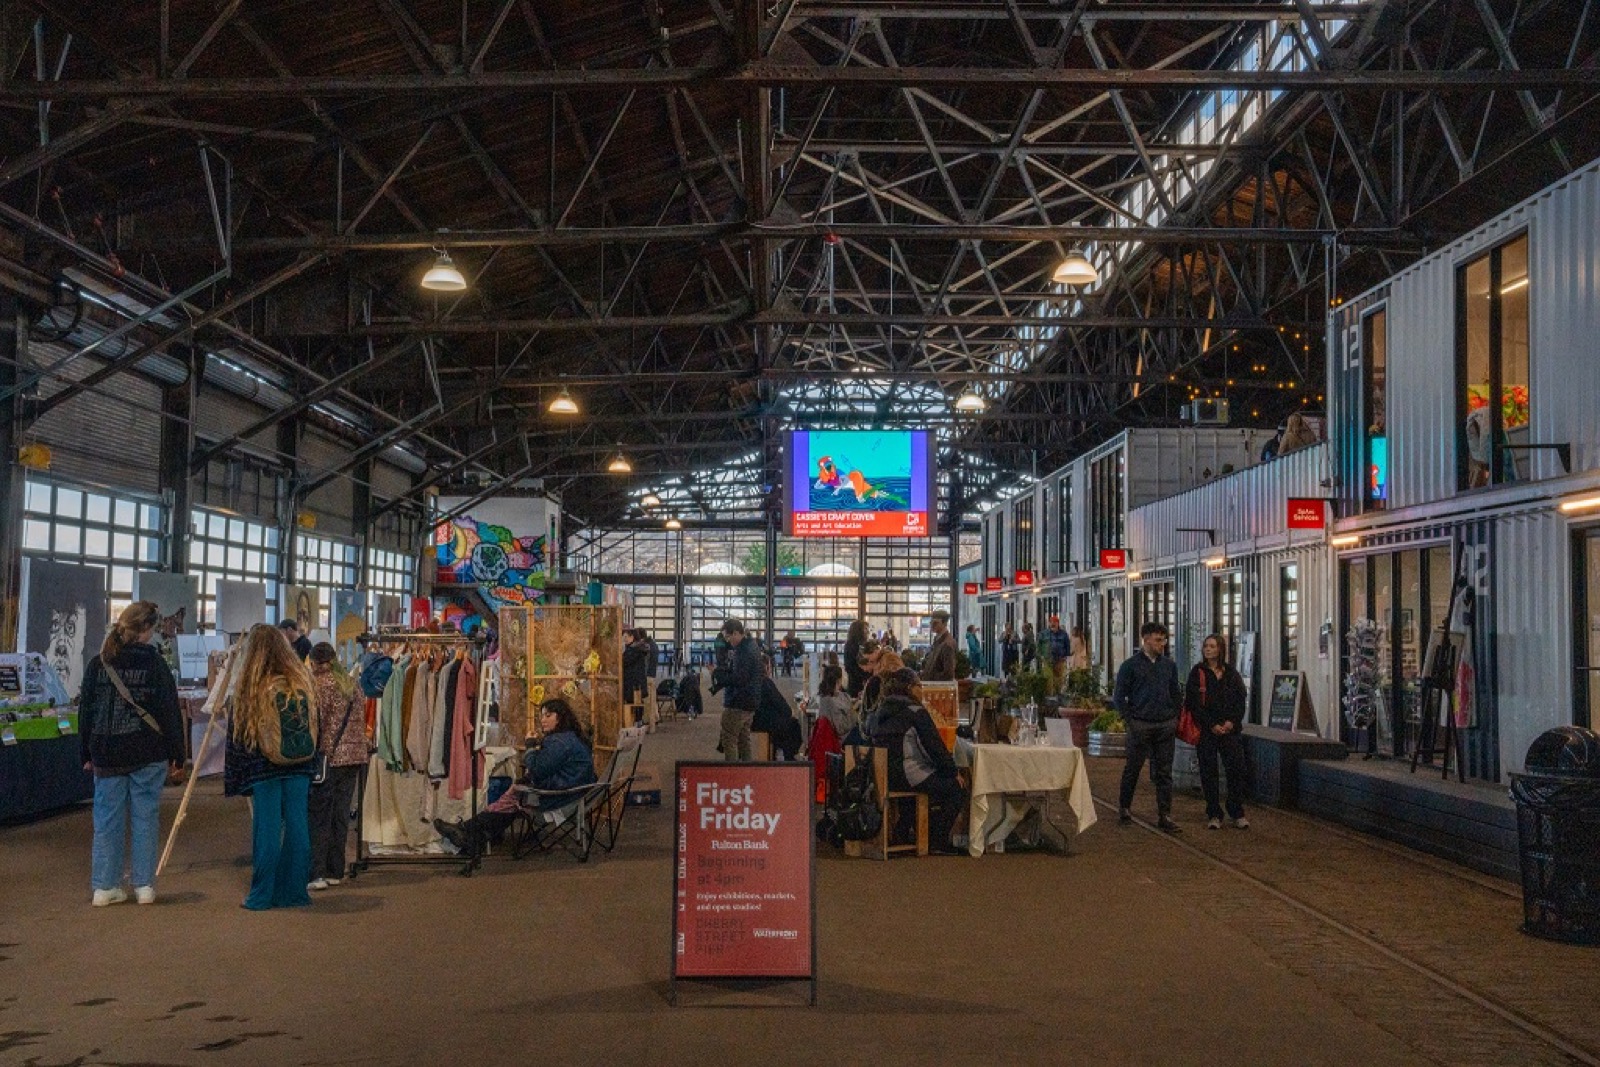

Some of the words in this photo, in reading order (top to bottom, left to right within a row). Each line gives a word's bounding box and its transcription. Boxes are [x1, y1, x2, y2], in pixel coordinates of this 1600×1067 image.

[1341, 324, 1359, 371] 12
[696, 782, 755, 805] First
[700, 806, 781, 835] Friday
[743, 840, 769, 850] Bank
[697, 854, 766, 870] Beginning
[697, 874, 710, 885] at
[713, 873, 745, 887] 4pm
[696, 892, 717, 901] Enjoy
[696, 902, 711, 910] and
[712, 903, 732, 912] open
[696, 918, 745, 929] CHERRY
[696, 930, 745, 942] STREET
